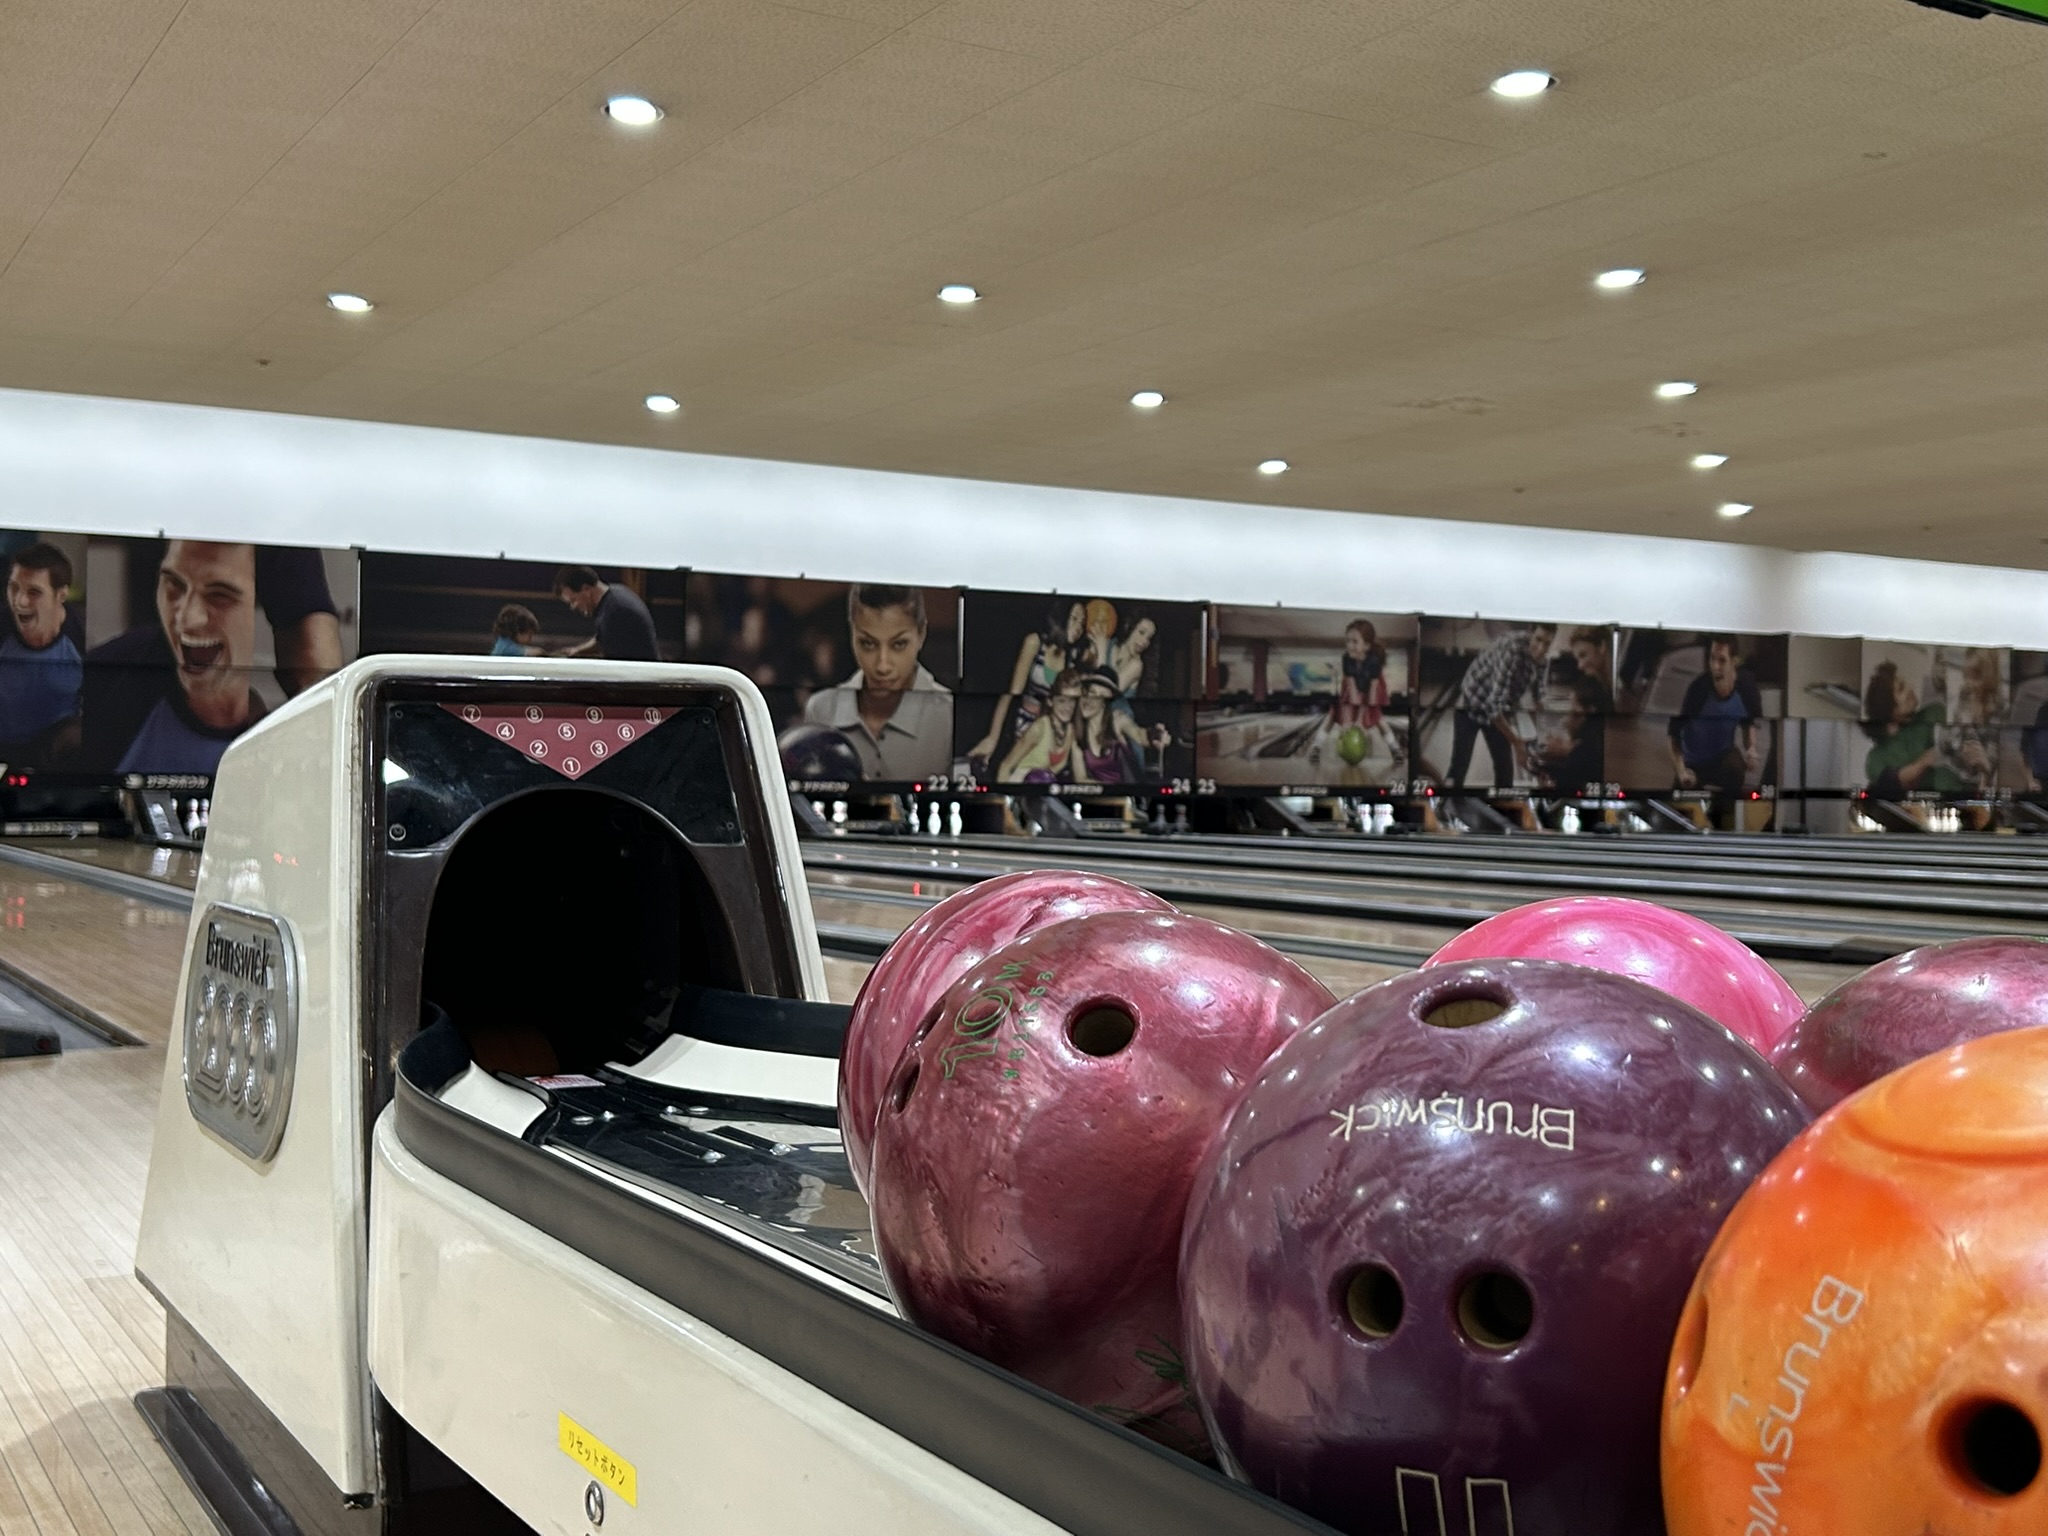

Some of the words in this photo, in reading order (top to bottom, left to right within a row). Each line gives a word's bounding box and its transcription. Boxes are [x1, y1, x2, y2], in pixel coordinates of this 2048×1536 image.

[928, 775, 949, 792] 22
[957, 776, 977, 792] 23
[1172, 778, 1191, 794] 24
[1198, 779, 1216, 795] 25
[1390, 780, 1406, 796] 26
[205, 921, 271, 987] Brunswick
[1329, 1096, 1576, 1151] Brunswick
[568, 1430, 626, 1486] リセットボタン
